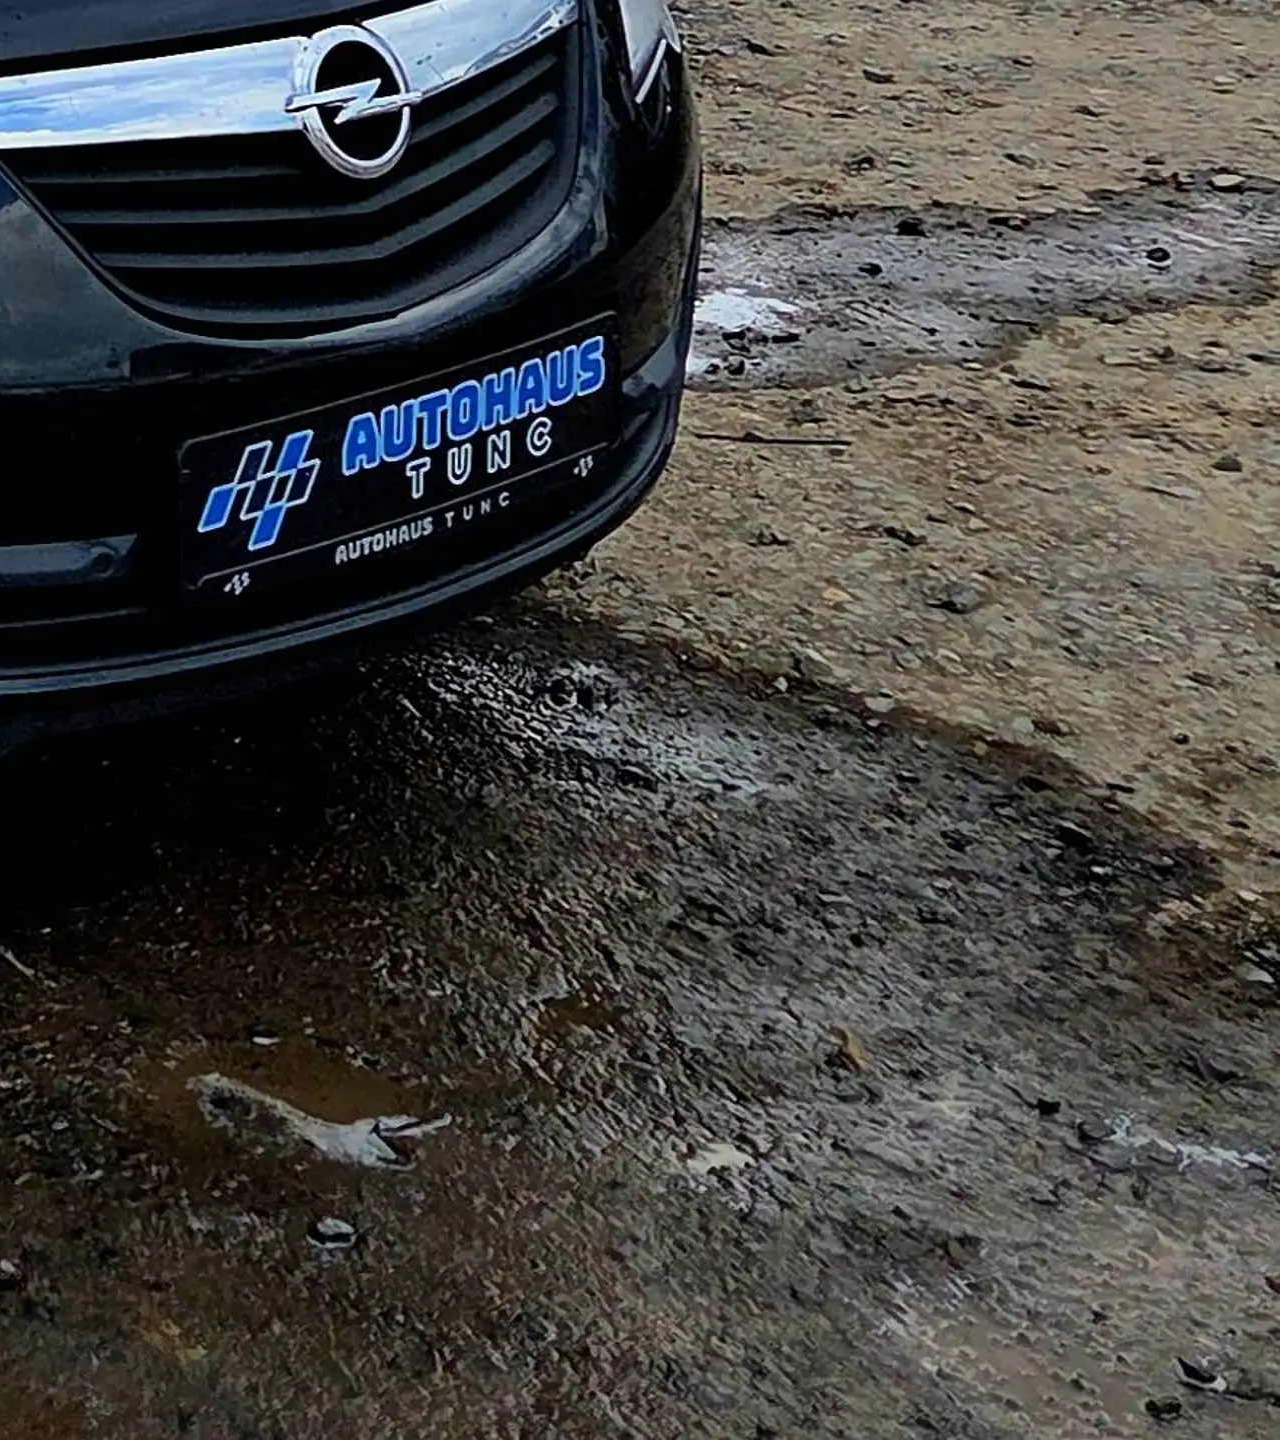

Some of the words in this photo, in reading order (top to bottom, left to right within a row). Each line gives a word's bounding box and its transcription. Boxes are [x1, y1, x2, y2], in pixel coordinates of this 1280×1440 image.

[341, 335, 605, 475] AUTOHAUS
[405, 417, 553, 498] TUNC
[334, 515, 434, 565] AUTOHAUS
[444, 491, 511, 528] TUNC
